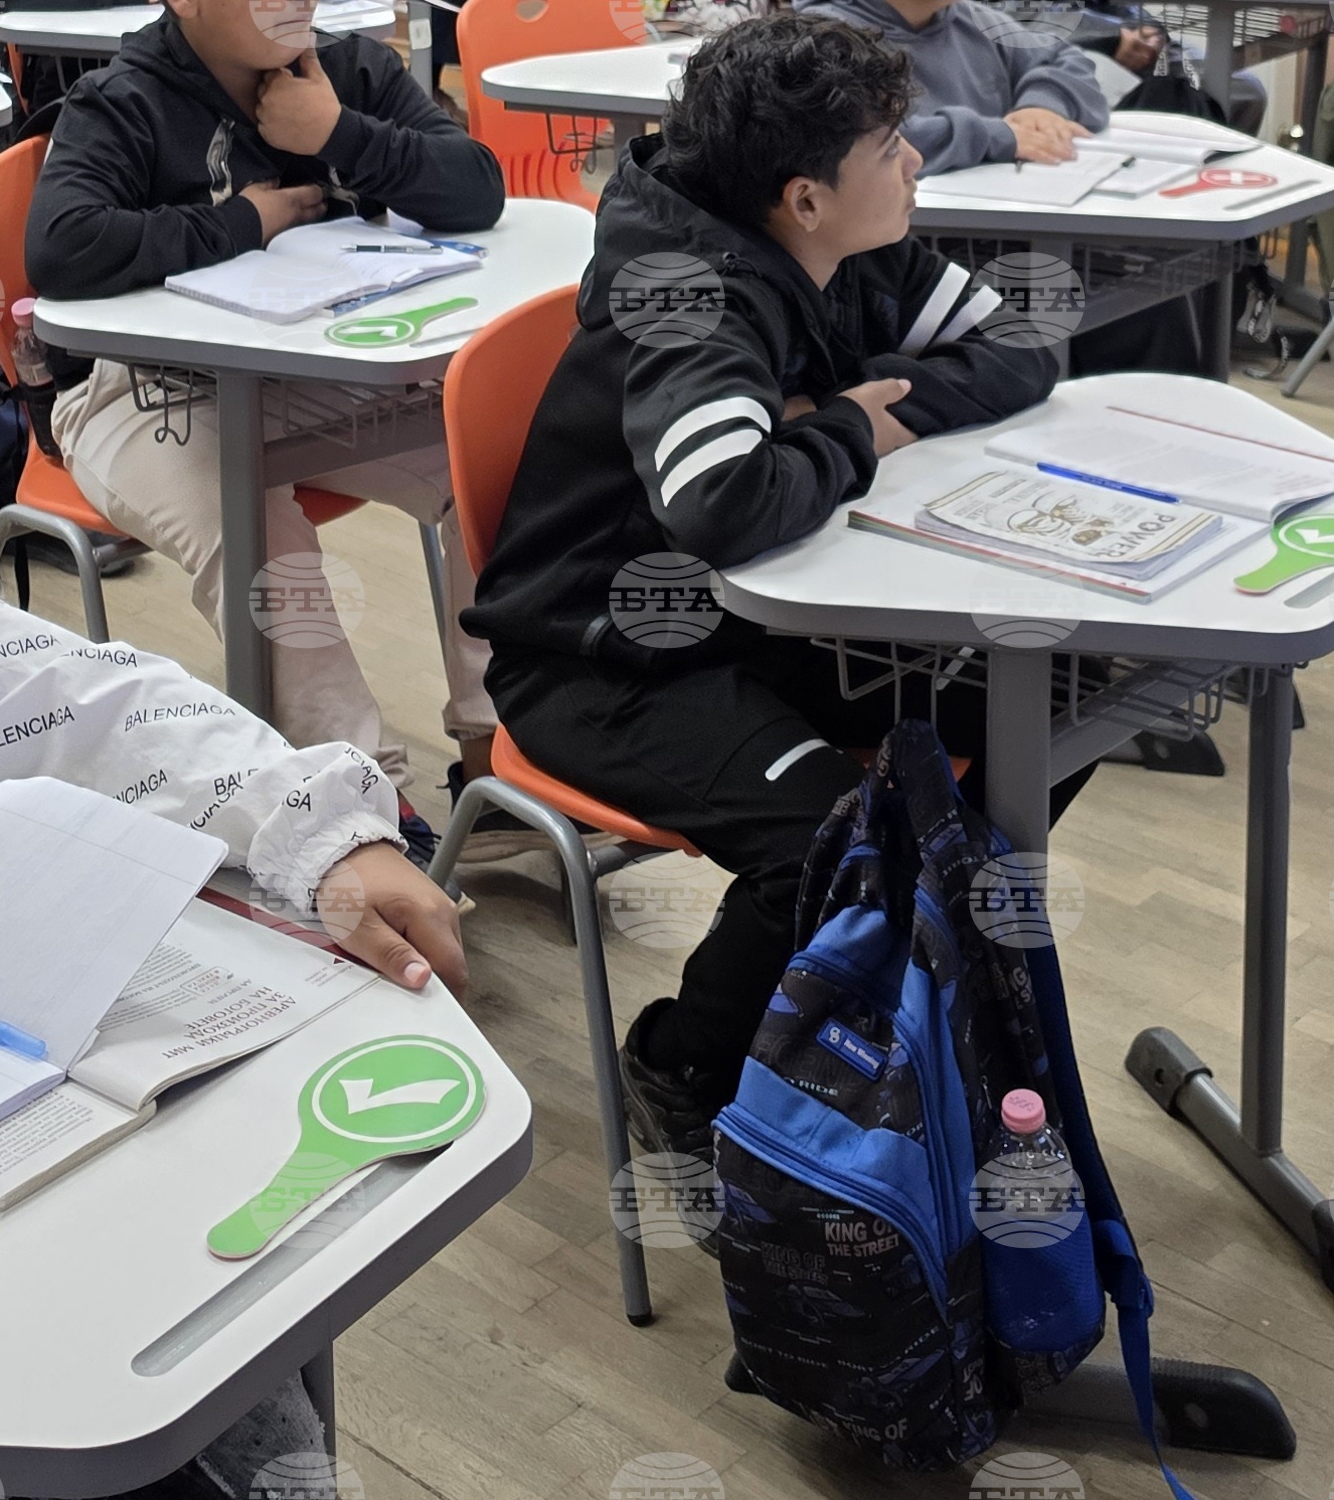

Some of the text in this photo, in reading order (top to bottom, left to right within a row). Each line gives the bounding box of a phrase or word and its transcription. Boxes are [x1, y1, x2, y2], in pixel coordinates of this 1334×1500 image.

[125, 702, 236, 732] BALENCIAGA
[184, 986, 273, 1030] НА БОГОВЕТЕ
[161, 1043, 194, 1059] МИТ
[799, 1079, 839, 1097] RIDE
[825, 1221, 867, 1243] KING
[826, 1234, 899, 1258] THE STREET
[884, 1418, 908, 1440] OF
